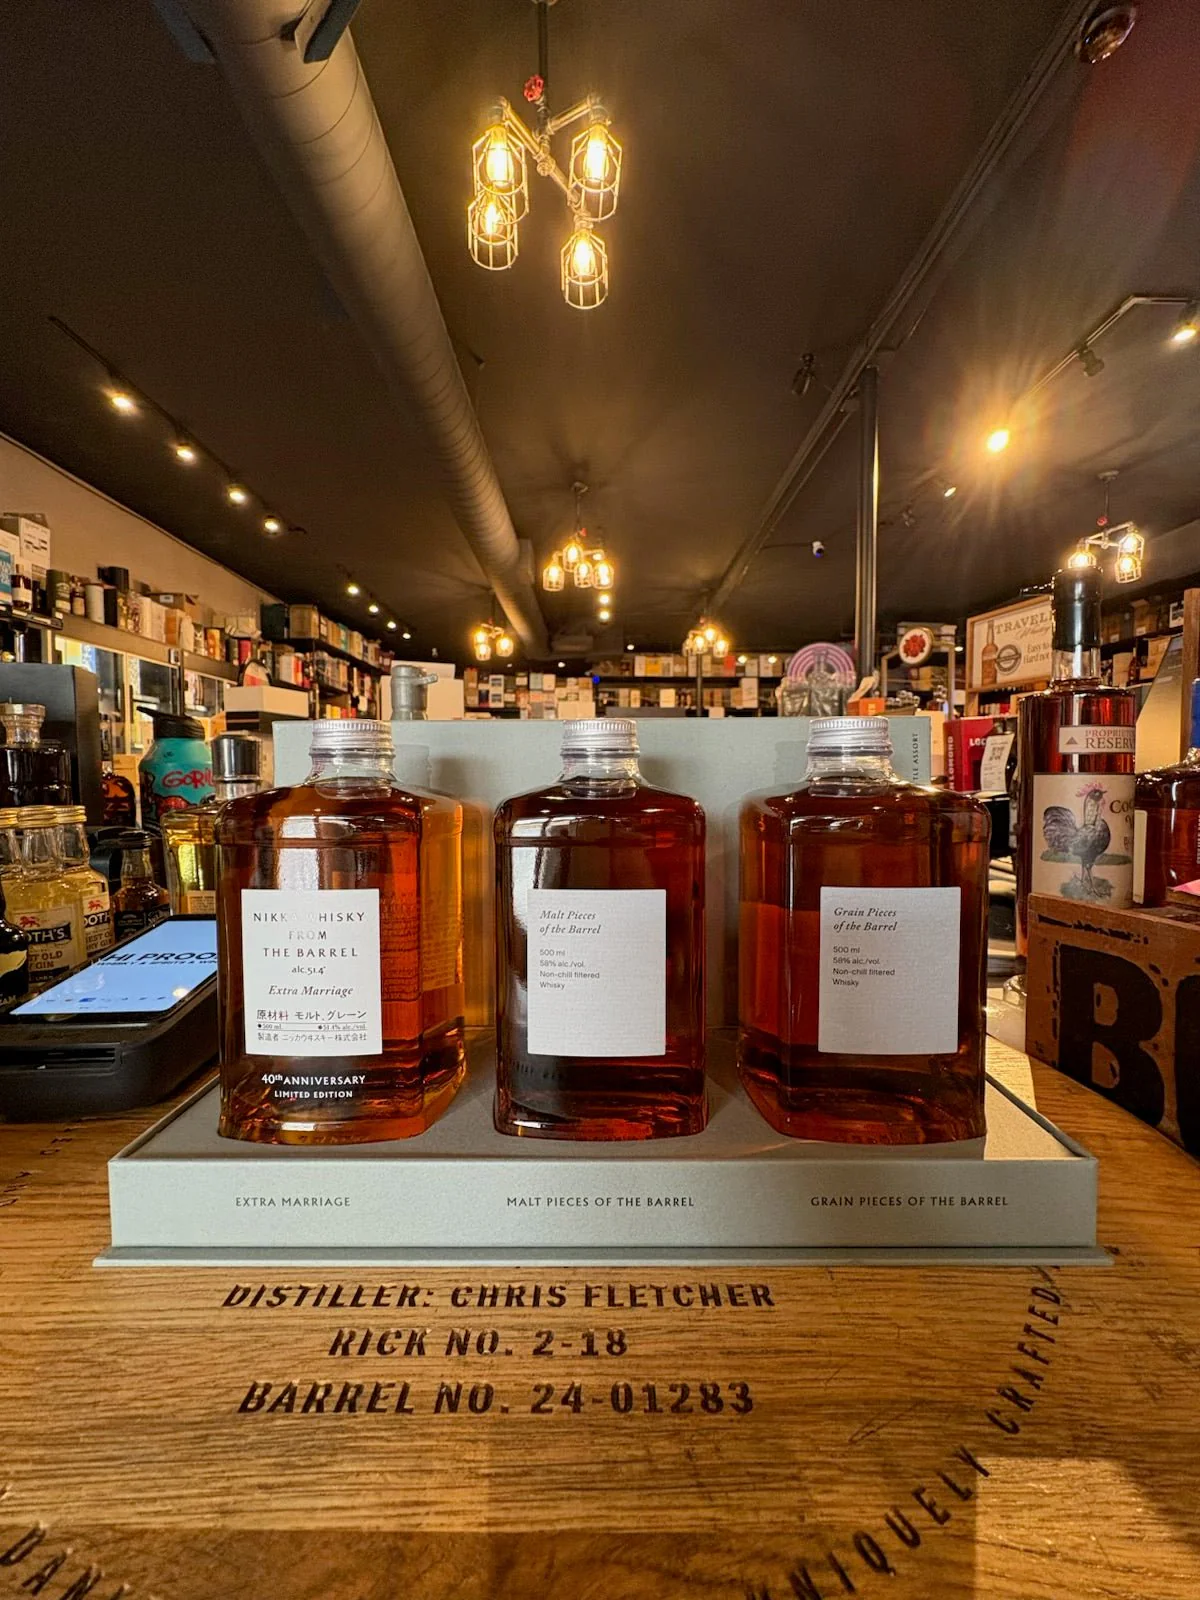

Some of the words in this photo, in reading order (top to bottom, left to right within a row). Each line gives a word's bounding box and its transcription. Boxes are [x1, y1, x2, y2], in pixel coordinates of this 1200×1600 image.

[540, 910, 565, 920] Malt
[567, 910, 597, 920] Pieces
[834, 907, 864, 917] Grain
[867, 907, 897, 917] Pieces
[539, 924, 551, 936] of
[551, 924, 566, 934] the
[568, 924, 602, 935] Barrel
[833, 921, 845, 933] of
[846, 921, 862, 931] the
[864, 921, 898, 931] Barrel
[288, 931, 327, 940] FROM
[41, 950, 63, 960] OLD
[103, 953, 136, 961] HI
[137, 952, 217, 961] PROO
[263, 948, 290, 957] THE
[297, 948, 358, 957] BARREL
[35, 961, 55, 970] GIN
[833, 957, 851, 965] 58%
[539, 971, 573, 979] Non-chill
[574, 971, 600, 979] filtered
[869, 968, 895, 976] filtered
[539, 981, 566, 990] Whisky
[832, 979, 859, 988] Whisky
[268, 985, 298, 996] Extra
[300, 985, 354, 998] Marriage
[256, 1009, 289, 1021] 原材料
[283, 1075, 366, 1085] ANNIVERSARY
[274, 1090, 310, 1098] LIMITED
[313, 1090, 353, 1098] EDITION
[235, 1197, 277, 1206] EXTRA
[281, 1197, 351, 1206] MARRIAGE
[507, 1197, 542, 1207] MALT
[546, 1197, 589, 1207] PIECES
[594, 1197, 612, 1207] OF
[617, 1197, 642, 1207] THE
[646, 1197, 695, 1207] BARREL
[810, 1196, 854, 1207] GRAIN
[859, 1196, 903, 1207] PIECES
[908, 1196, 925, 1207] OF
[930, 1196, 955, 1207] THE
[960, 1196, 1009, 1207] BARREL
[221, 1283, 433, 1308] DISTILLER:
[451, 1283, 568, 1308] CHRIS
[584, 1283, 776, 1308] FLETCHER
[328, 1328, 431, 1357] RICK
[445, 1328, 514, 1357] NO.
[533, 1328, 628, 1357] 2-18
[237, 1380, 416, 1415] BARREL
[433, 1380, 510, 1415] NO.
[532, 1380, 755, 1415] 24-01283
[744, 1444, 991, 1600] NIQUELY
[984, 1285, 1061, 1435] CRAFTED
